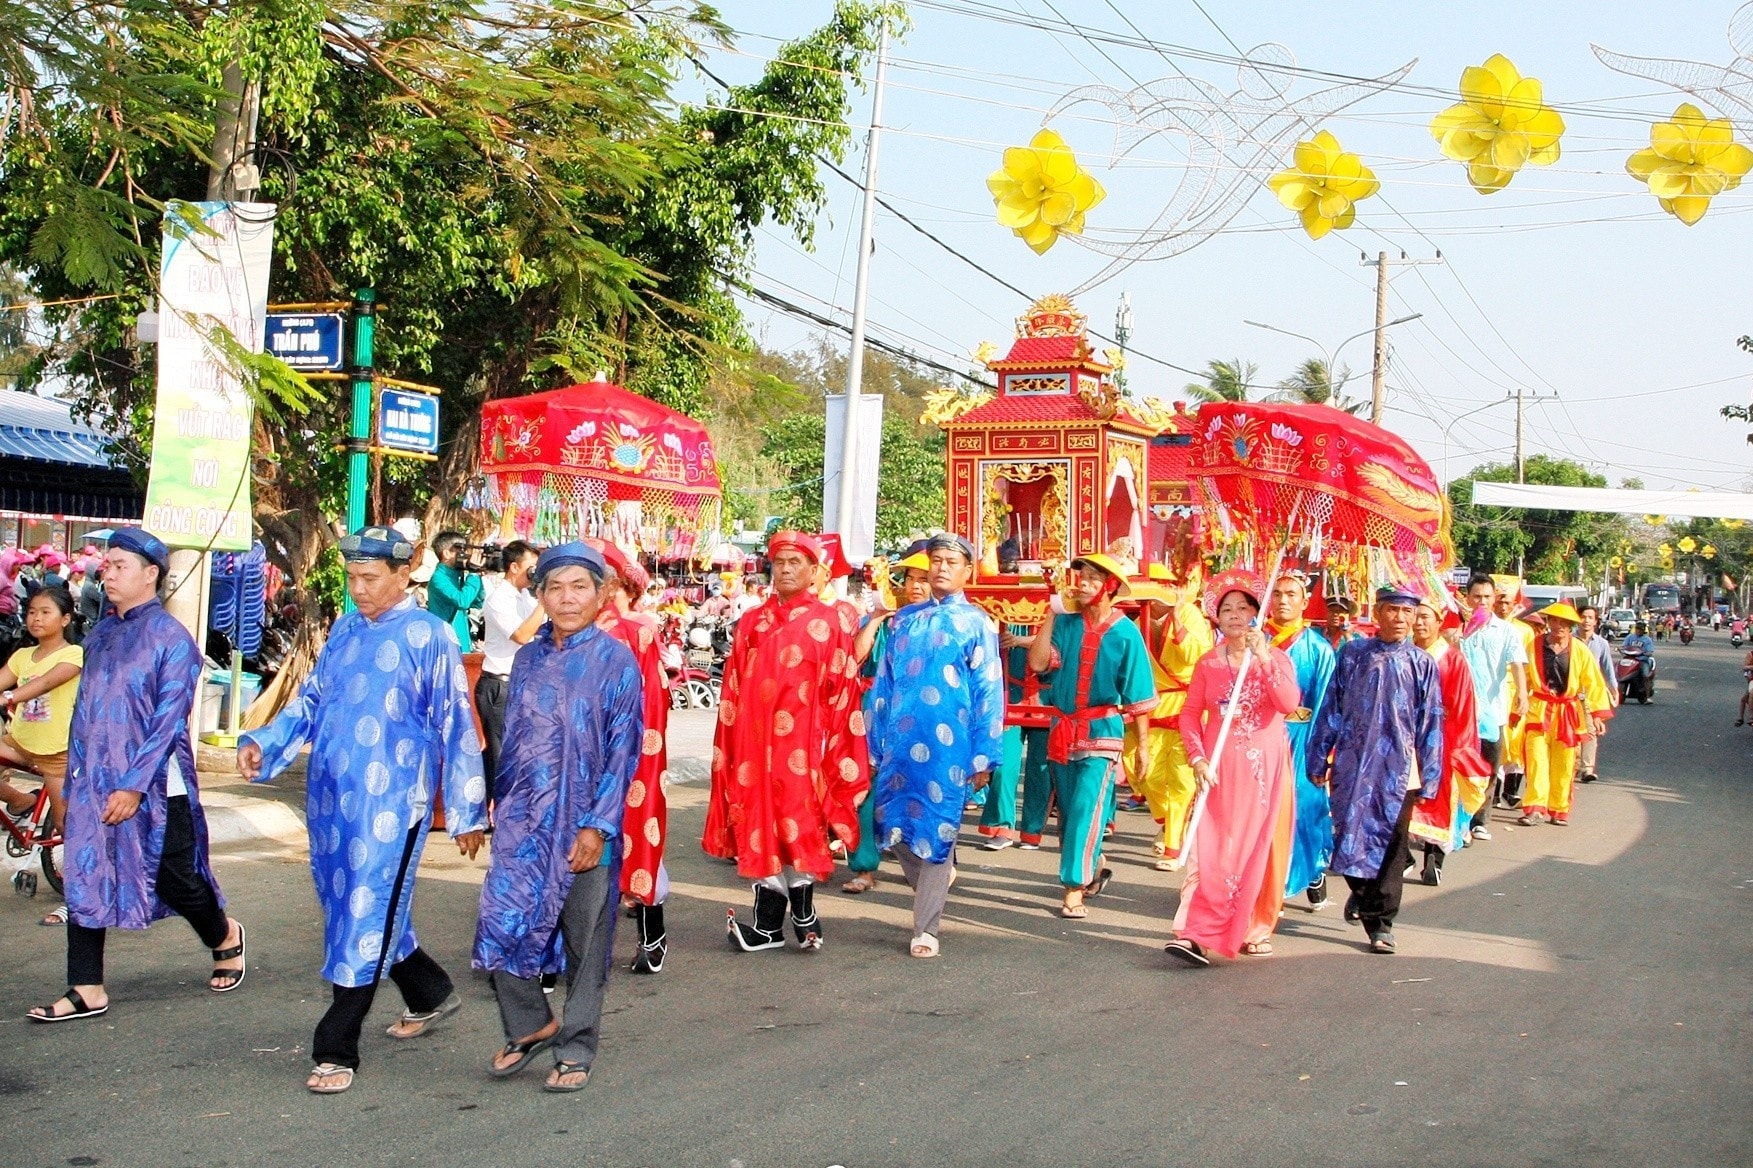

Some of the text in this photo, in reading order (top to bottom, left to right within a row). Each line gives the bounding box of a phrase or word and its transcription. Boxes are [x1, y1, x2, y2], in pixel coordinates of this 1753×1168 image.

[178, 402, 243, 441] VỨT RÁC
[191, 456, 220, 488] NƠI
[149, 498, 193, 534] CÔNG
[195, 501, 239, 541] CỘNG
